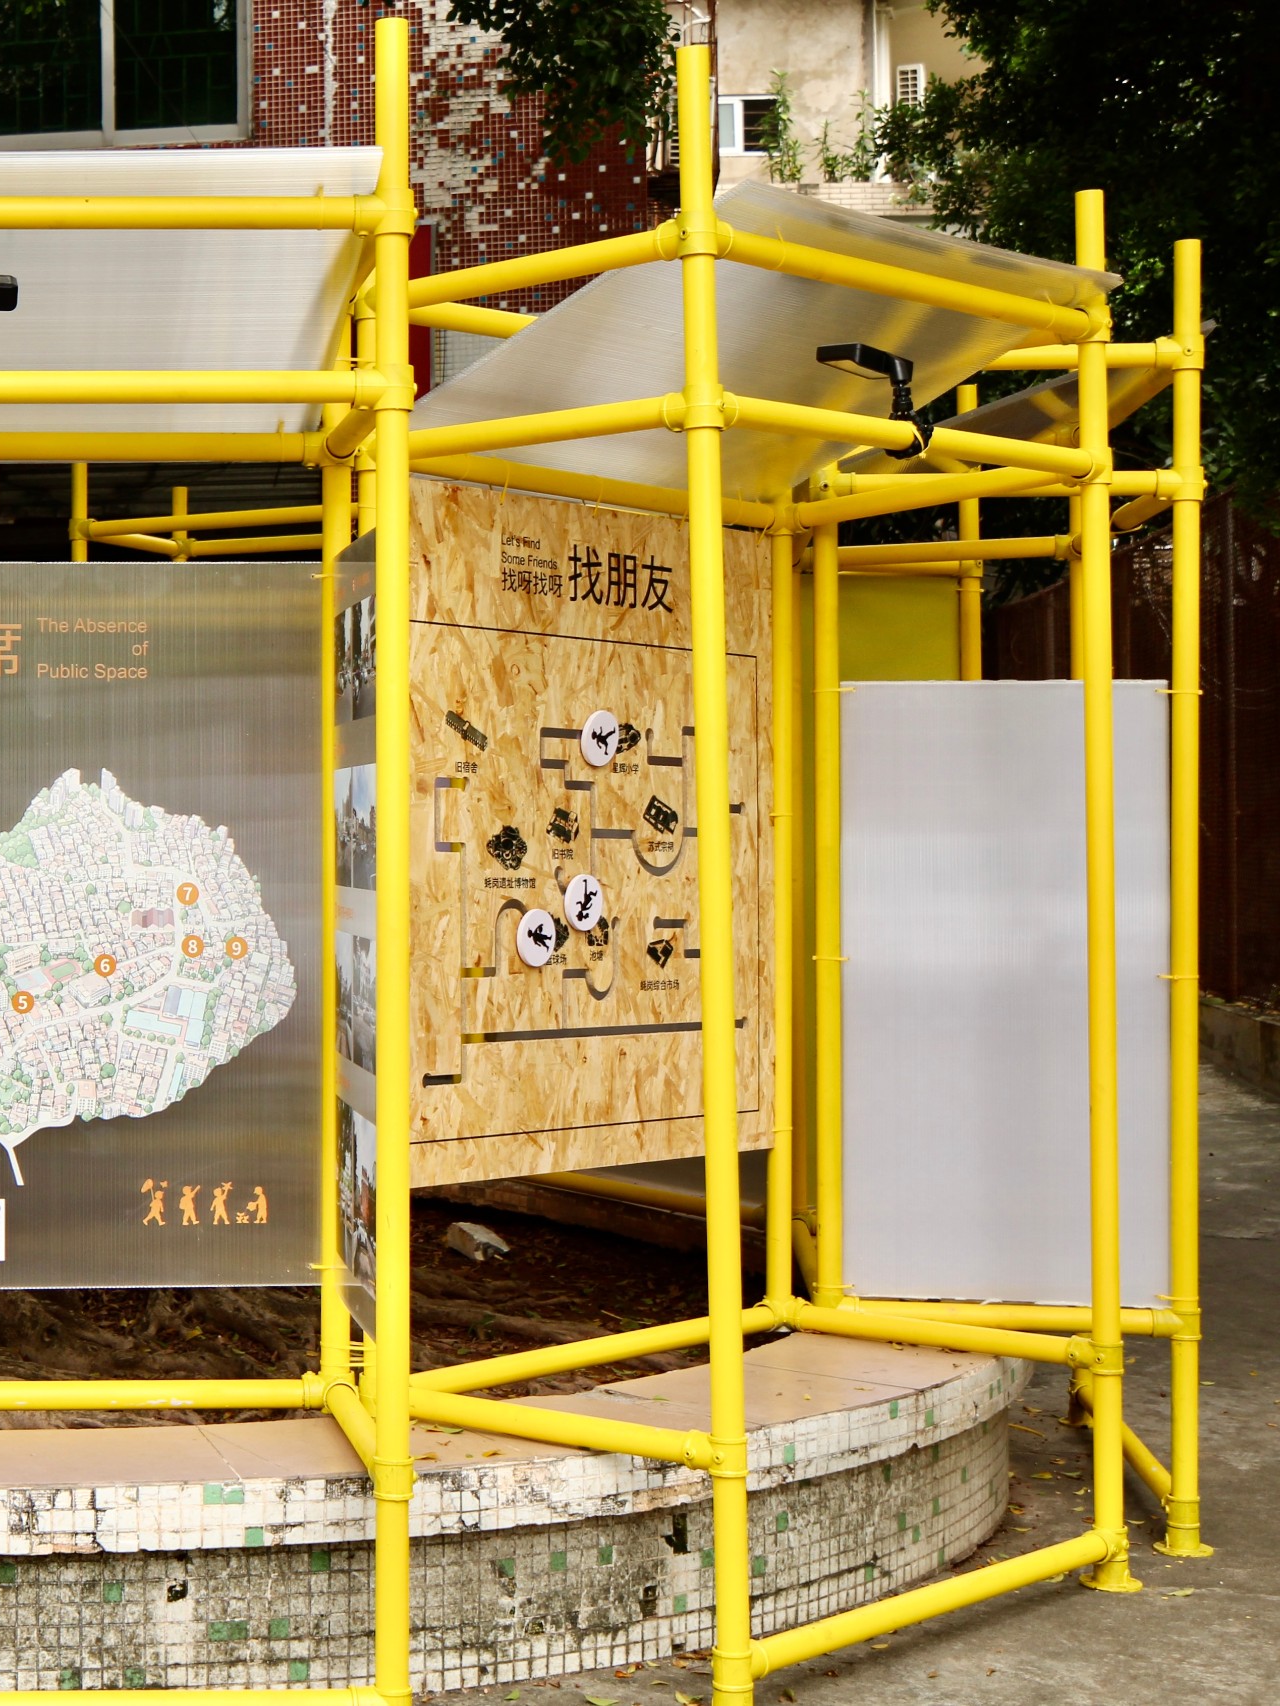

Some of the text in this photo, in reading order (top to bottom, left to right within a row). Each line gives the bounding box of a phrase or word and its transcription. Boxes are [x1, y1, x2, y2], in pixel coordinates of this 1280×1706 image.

[501, 534, 540, 550] Let's Find
[501, 552, 558, 570] Some Friends
[501, 567, 563, 598] 找呀找呀
[568, 544, 673, 614] 找朋友
[36, 617, 148, 633] The Absence
[132, 640, 148, 657] of
[36, 663, 148, 682] Public Space
[183, 886, 192, 901] 7
[188, 940, 197, 954] 8
[232, 941, 241, 955] 9
[100, 958, 110, 972] 6
[18, 996, 28, 1010] 5
